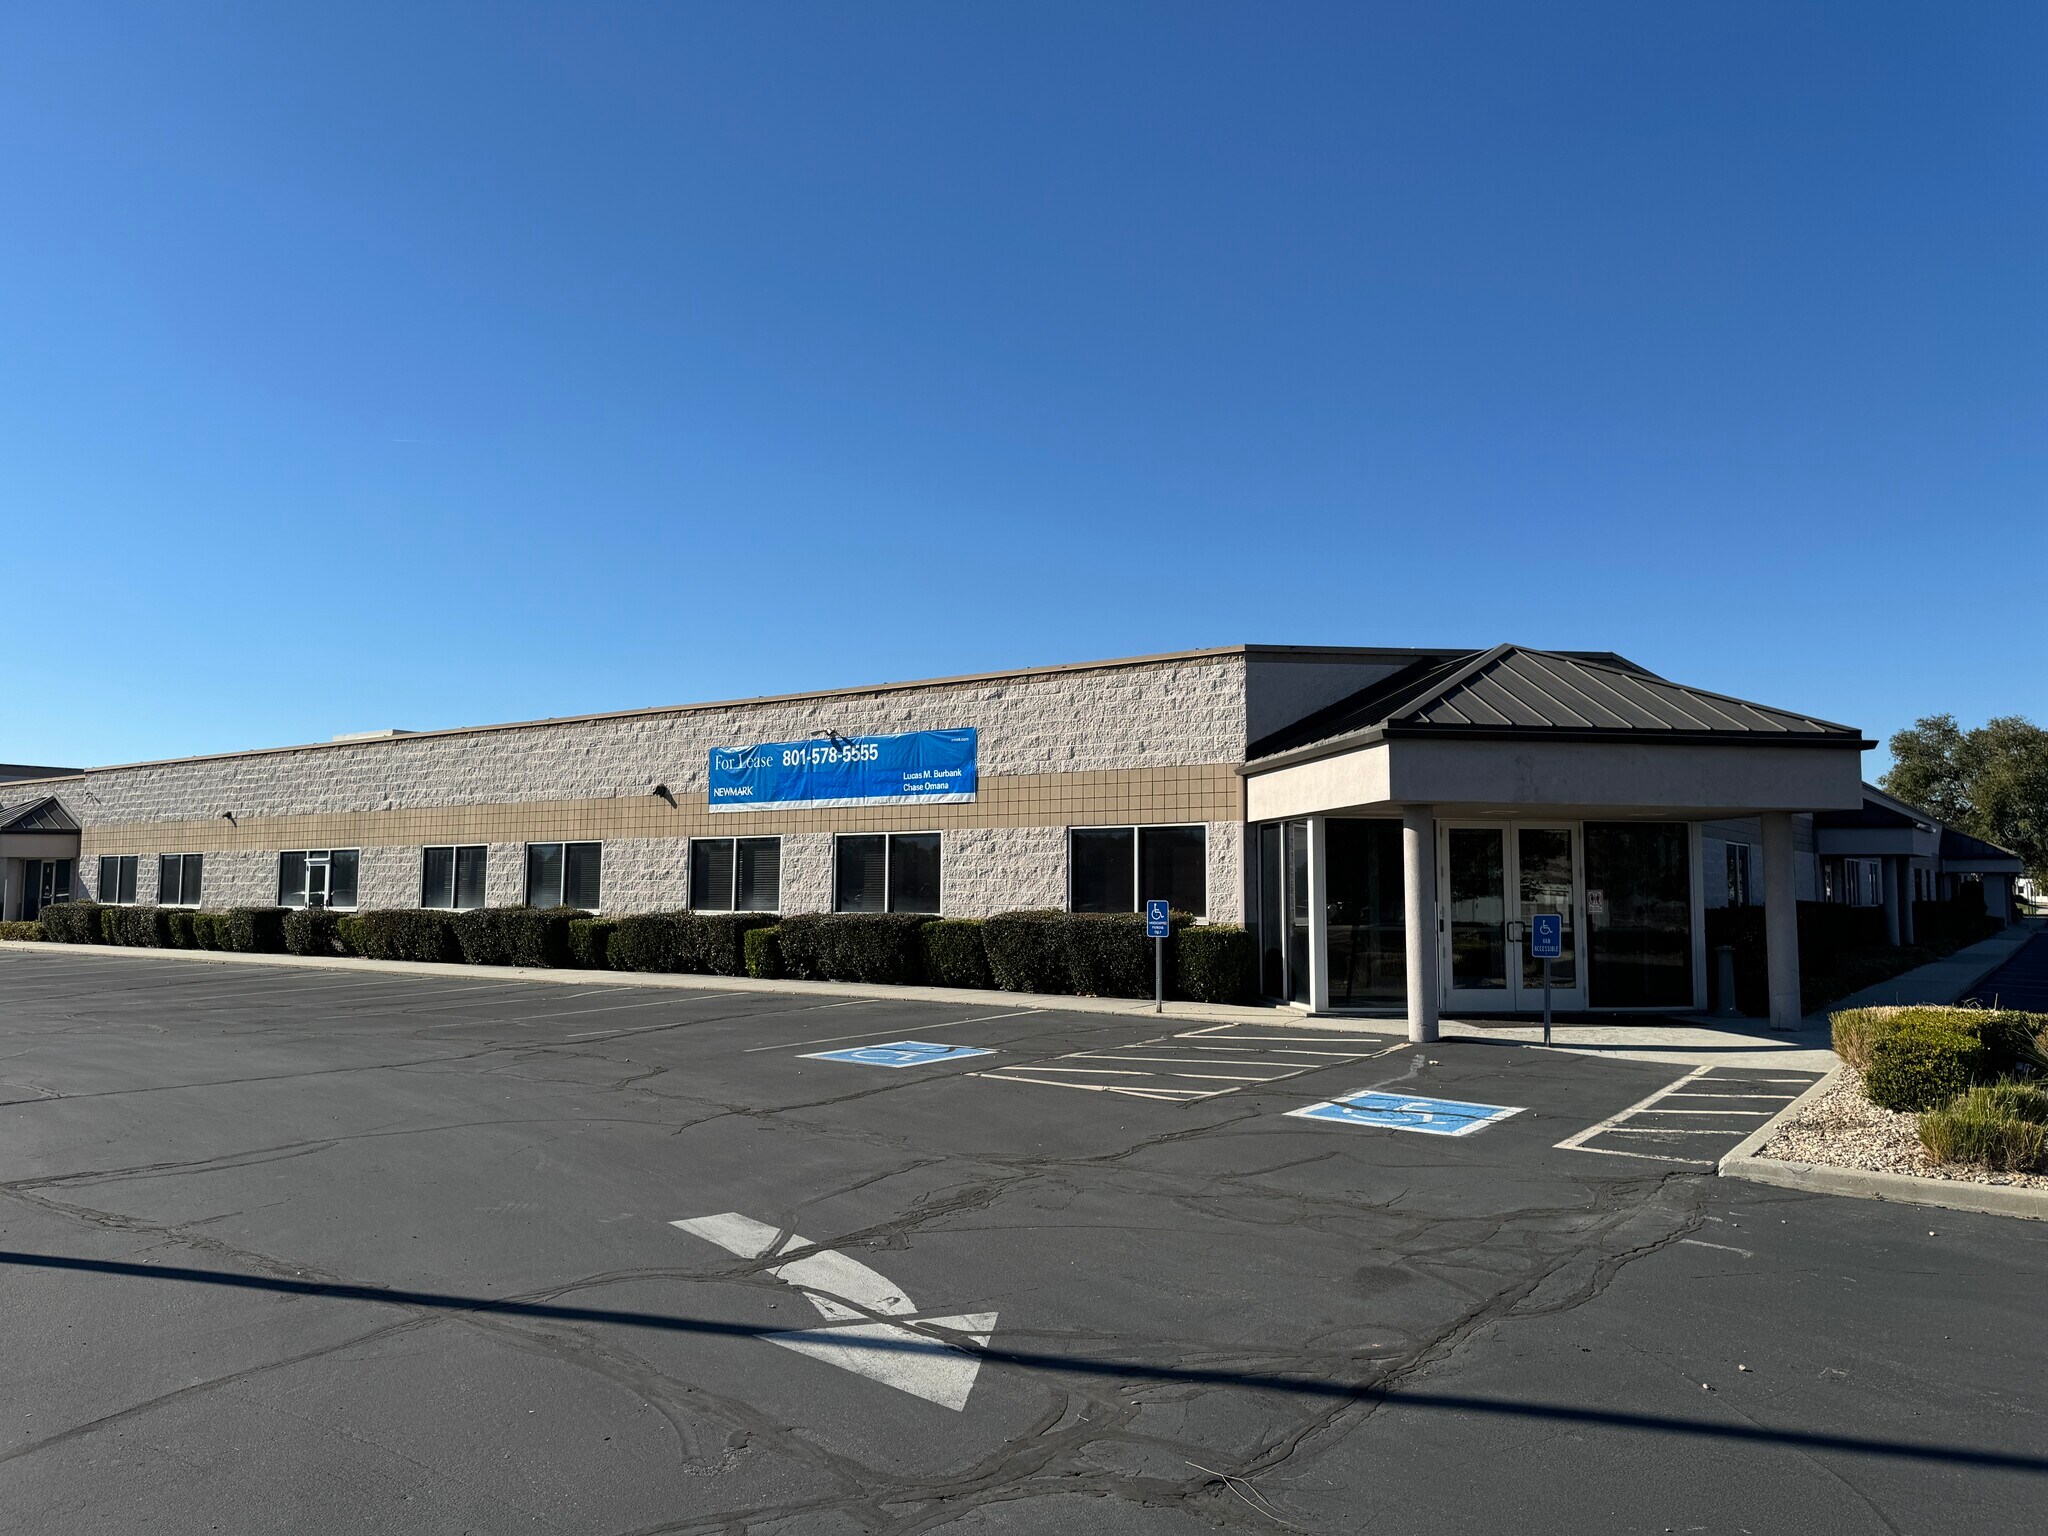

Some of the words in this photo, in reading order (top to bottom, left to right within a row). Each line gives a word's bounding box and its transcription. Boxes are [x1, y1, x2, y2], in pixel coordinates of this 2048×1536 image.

[715, 753, 735, 771] For
[739, 752, 774, 769] Lease
[783, 744, 878, 766] 801-578-5555
[903, 771, 923, 780] Lucas
[923, 769, 933, 779] M.
[933, 768, 962, 778] Burbank
[713, 785, 754, 797] NEWMARK
[903, 782, 924, 791] Chase
[924, 781, 949, 790] Omana
